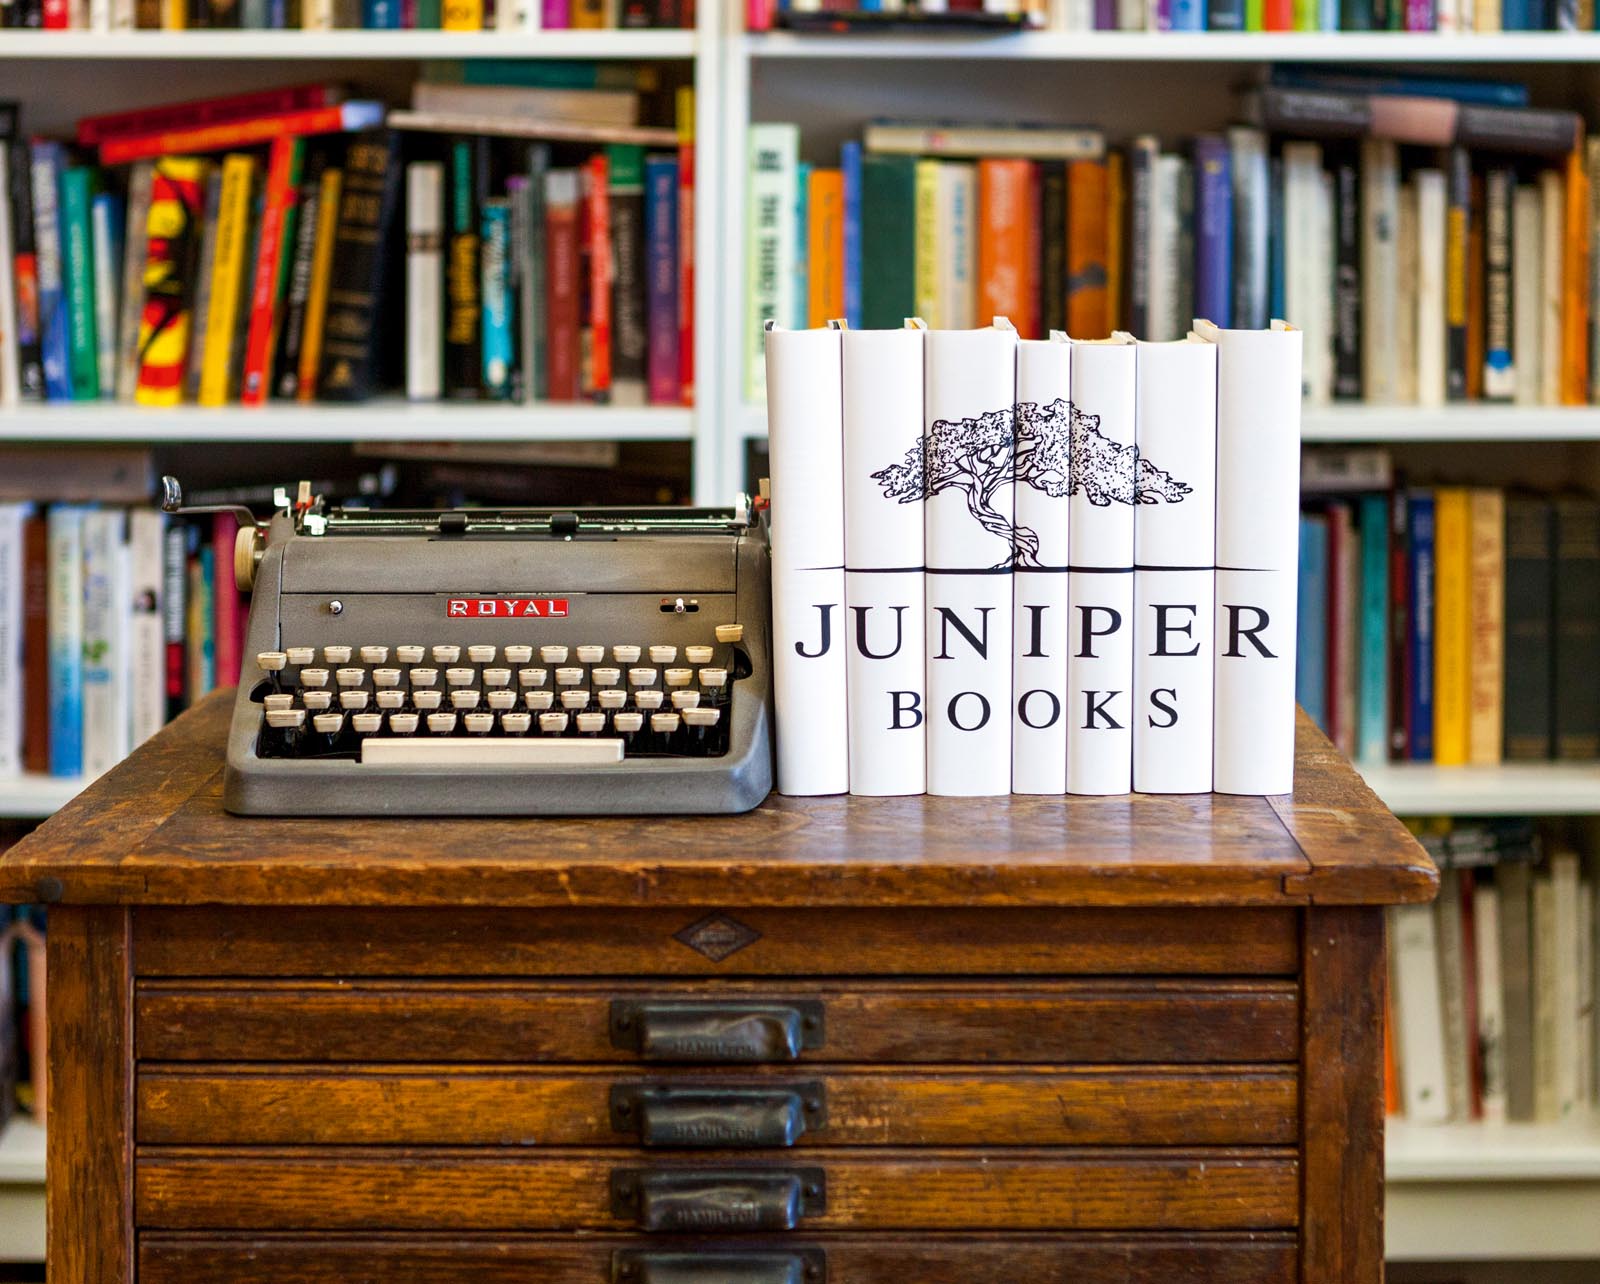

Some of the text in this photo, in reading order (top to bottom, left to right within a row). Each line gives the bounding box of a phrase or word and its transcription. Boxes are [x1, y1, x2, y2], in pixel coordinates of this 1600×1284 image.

[450, 600, 567, 616] ROYAL
[795, 603, 1279, 661] JUNIPER
[886, 688, 1179, 732] BOOKS
[674, 1122, 761, 1140] HAMILTON
